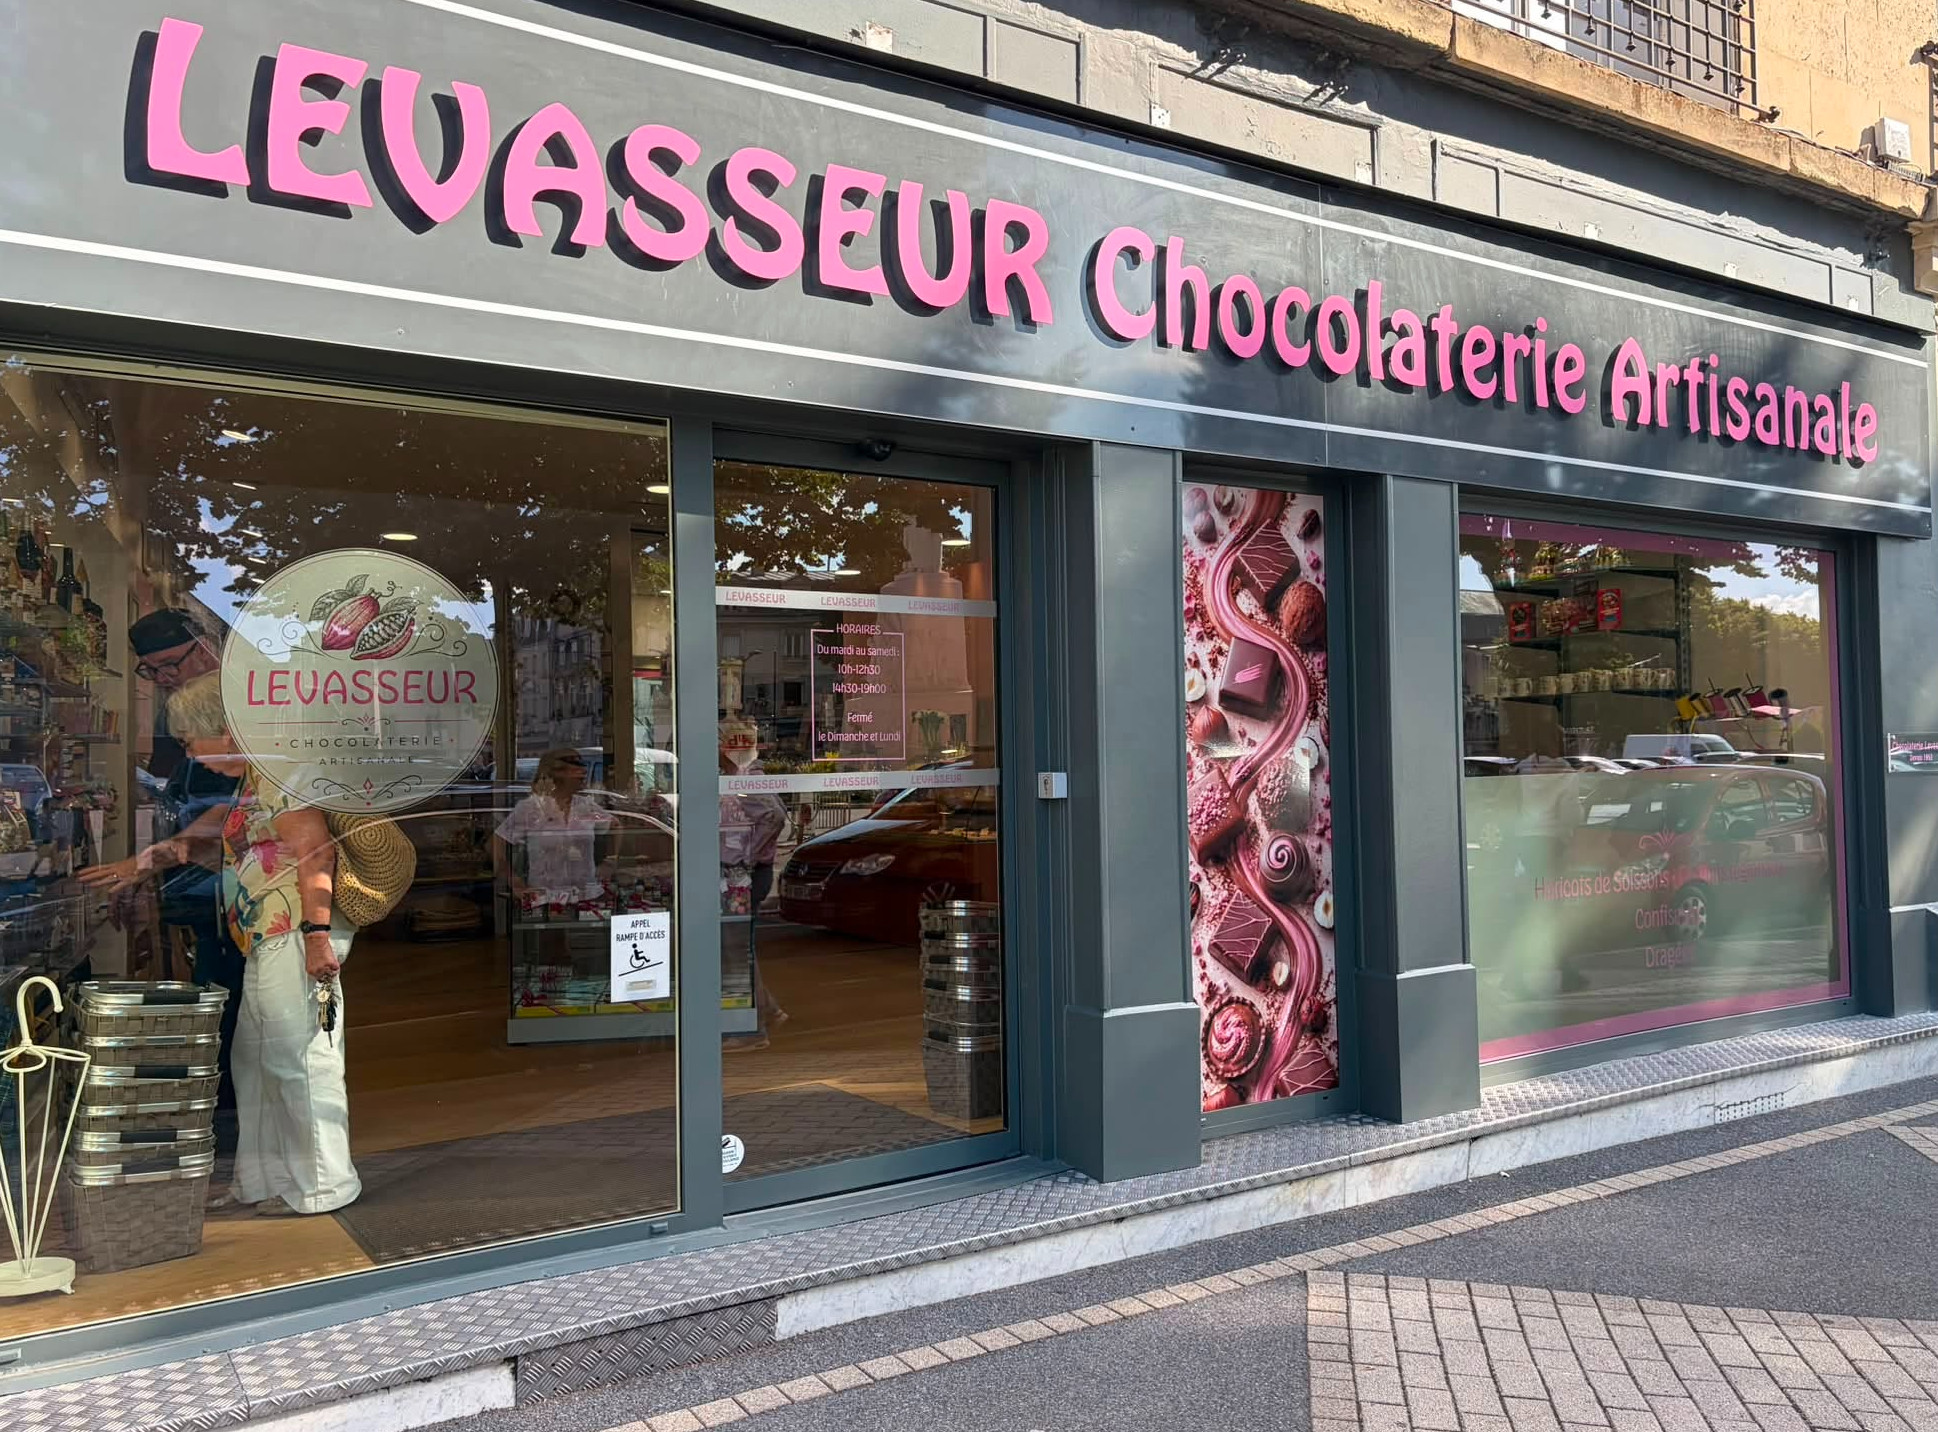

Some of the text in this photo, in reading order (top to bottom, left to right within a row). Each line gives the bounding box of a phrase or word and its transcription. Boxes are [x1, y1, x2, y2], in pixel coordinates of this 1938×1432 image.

[148, 18, 1877, 461] LEVASSEUR Chocolaterie Artisanale
[726, 590, 786, 604] LEVASSEUR
[820, 596, 876, 608] LEVASSEUR
[908, 600, 960, 613] LEVASSEUR
[836, 623, 881, 635] HORAIRES
[817, 644, 829, 654] Du
[830, 645, 854, 655] mardi
[855, 647, 866, 656] au
[838, 664, 881, 675] 10h-12h30
[247, 669, 478, 707] LEVASSEUR
[832, 683, 887, 694] 14h30-19h00
[847, 711, 873, 723] Fermé
[289, 736, 443, 749] CHOCOLATERIE
[818, 731, 901, 742] le Dimanche et Lundi
[319, 755, 415, 766] ARTISANALE
[728, 779, 788, 791] LEVASSEUR
[823, 776, 879, 788] LEVASSEUR
[911, 773, 962, 785] LEVASSEUR
[1594, 871, 1611, 894] de
[630, 919, 651, 928] APPEL
[616, 930, 666, 942] RAMPE D'ACCÈS
